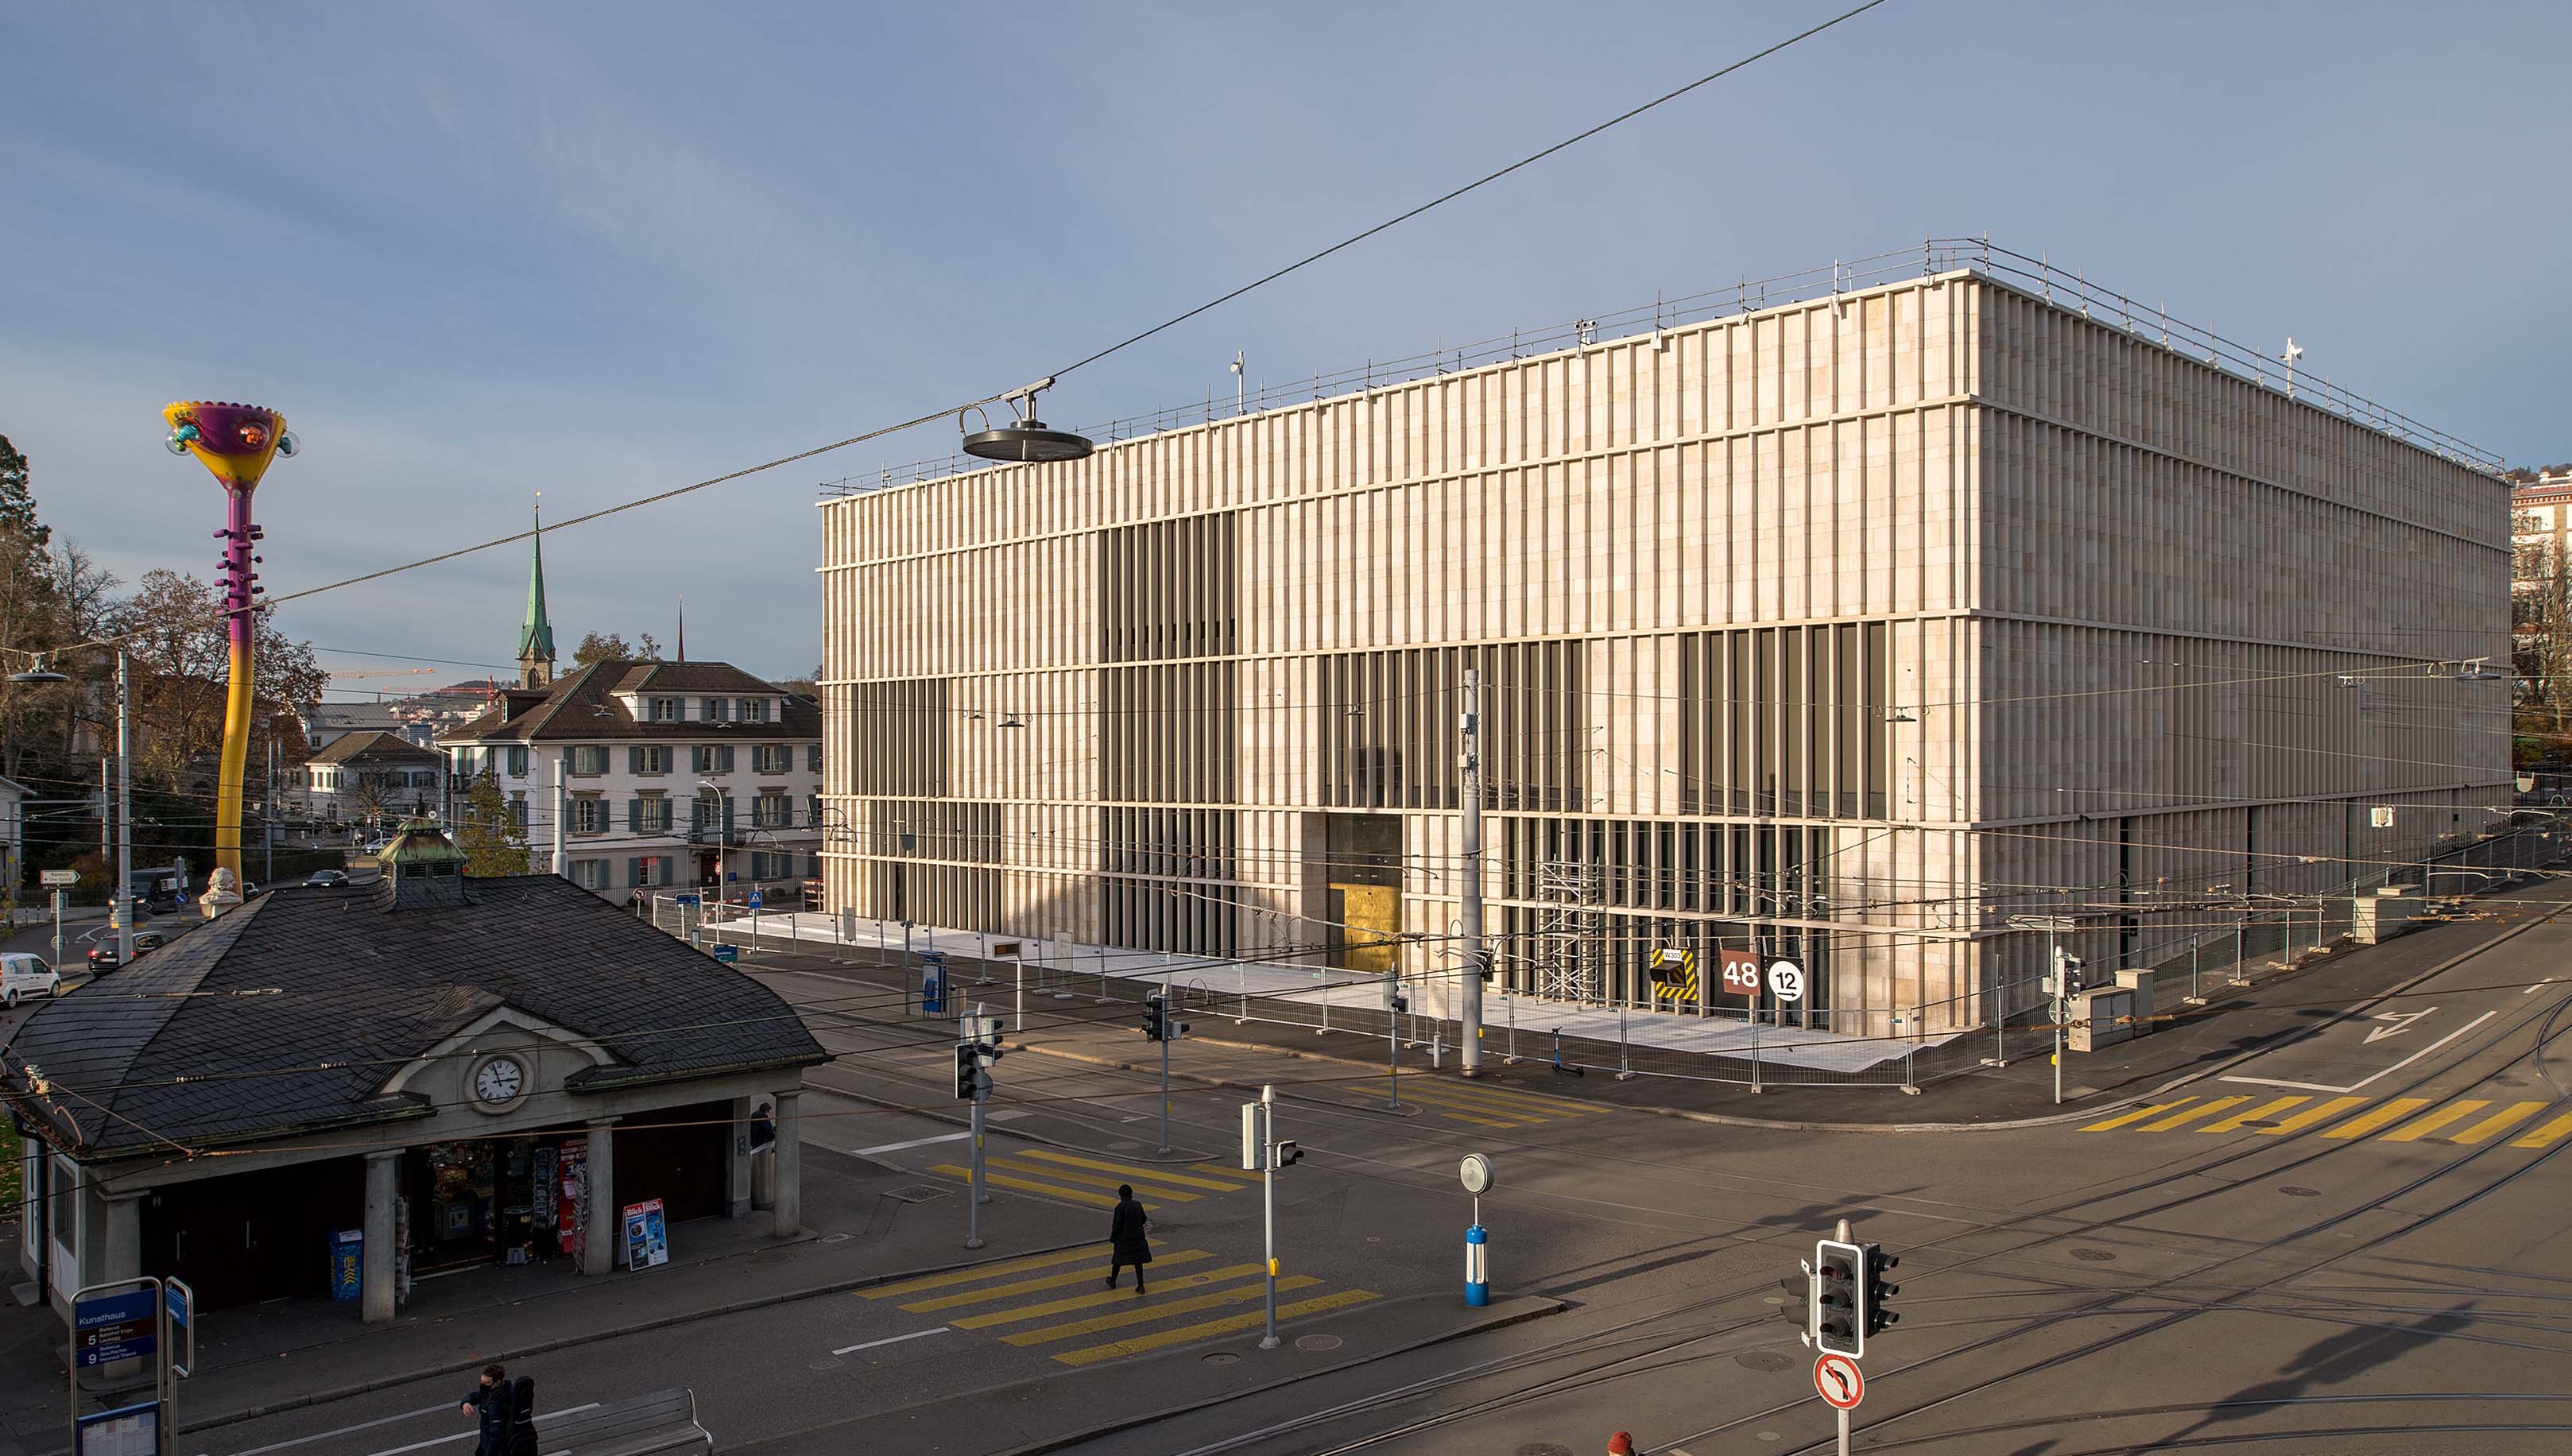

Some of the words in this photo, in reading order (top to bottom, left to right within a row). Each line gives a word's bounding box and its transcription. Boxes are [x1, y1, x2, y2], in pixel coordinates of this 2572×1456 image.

[1723, 961, 1759, 988] 48
[1776, 972, 1797, 989] 12
[626, 1206, 643, 1216] Blick
[645, 1201, 661, 1212] Blick
[79, 1311, 126, 1326] Kunsthaus
[88, 1335, 96, 1346] 5
[88, 1354, 97, 1364] 9
